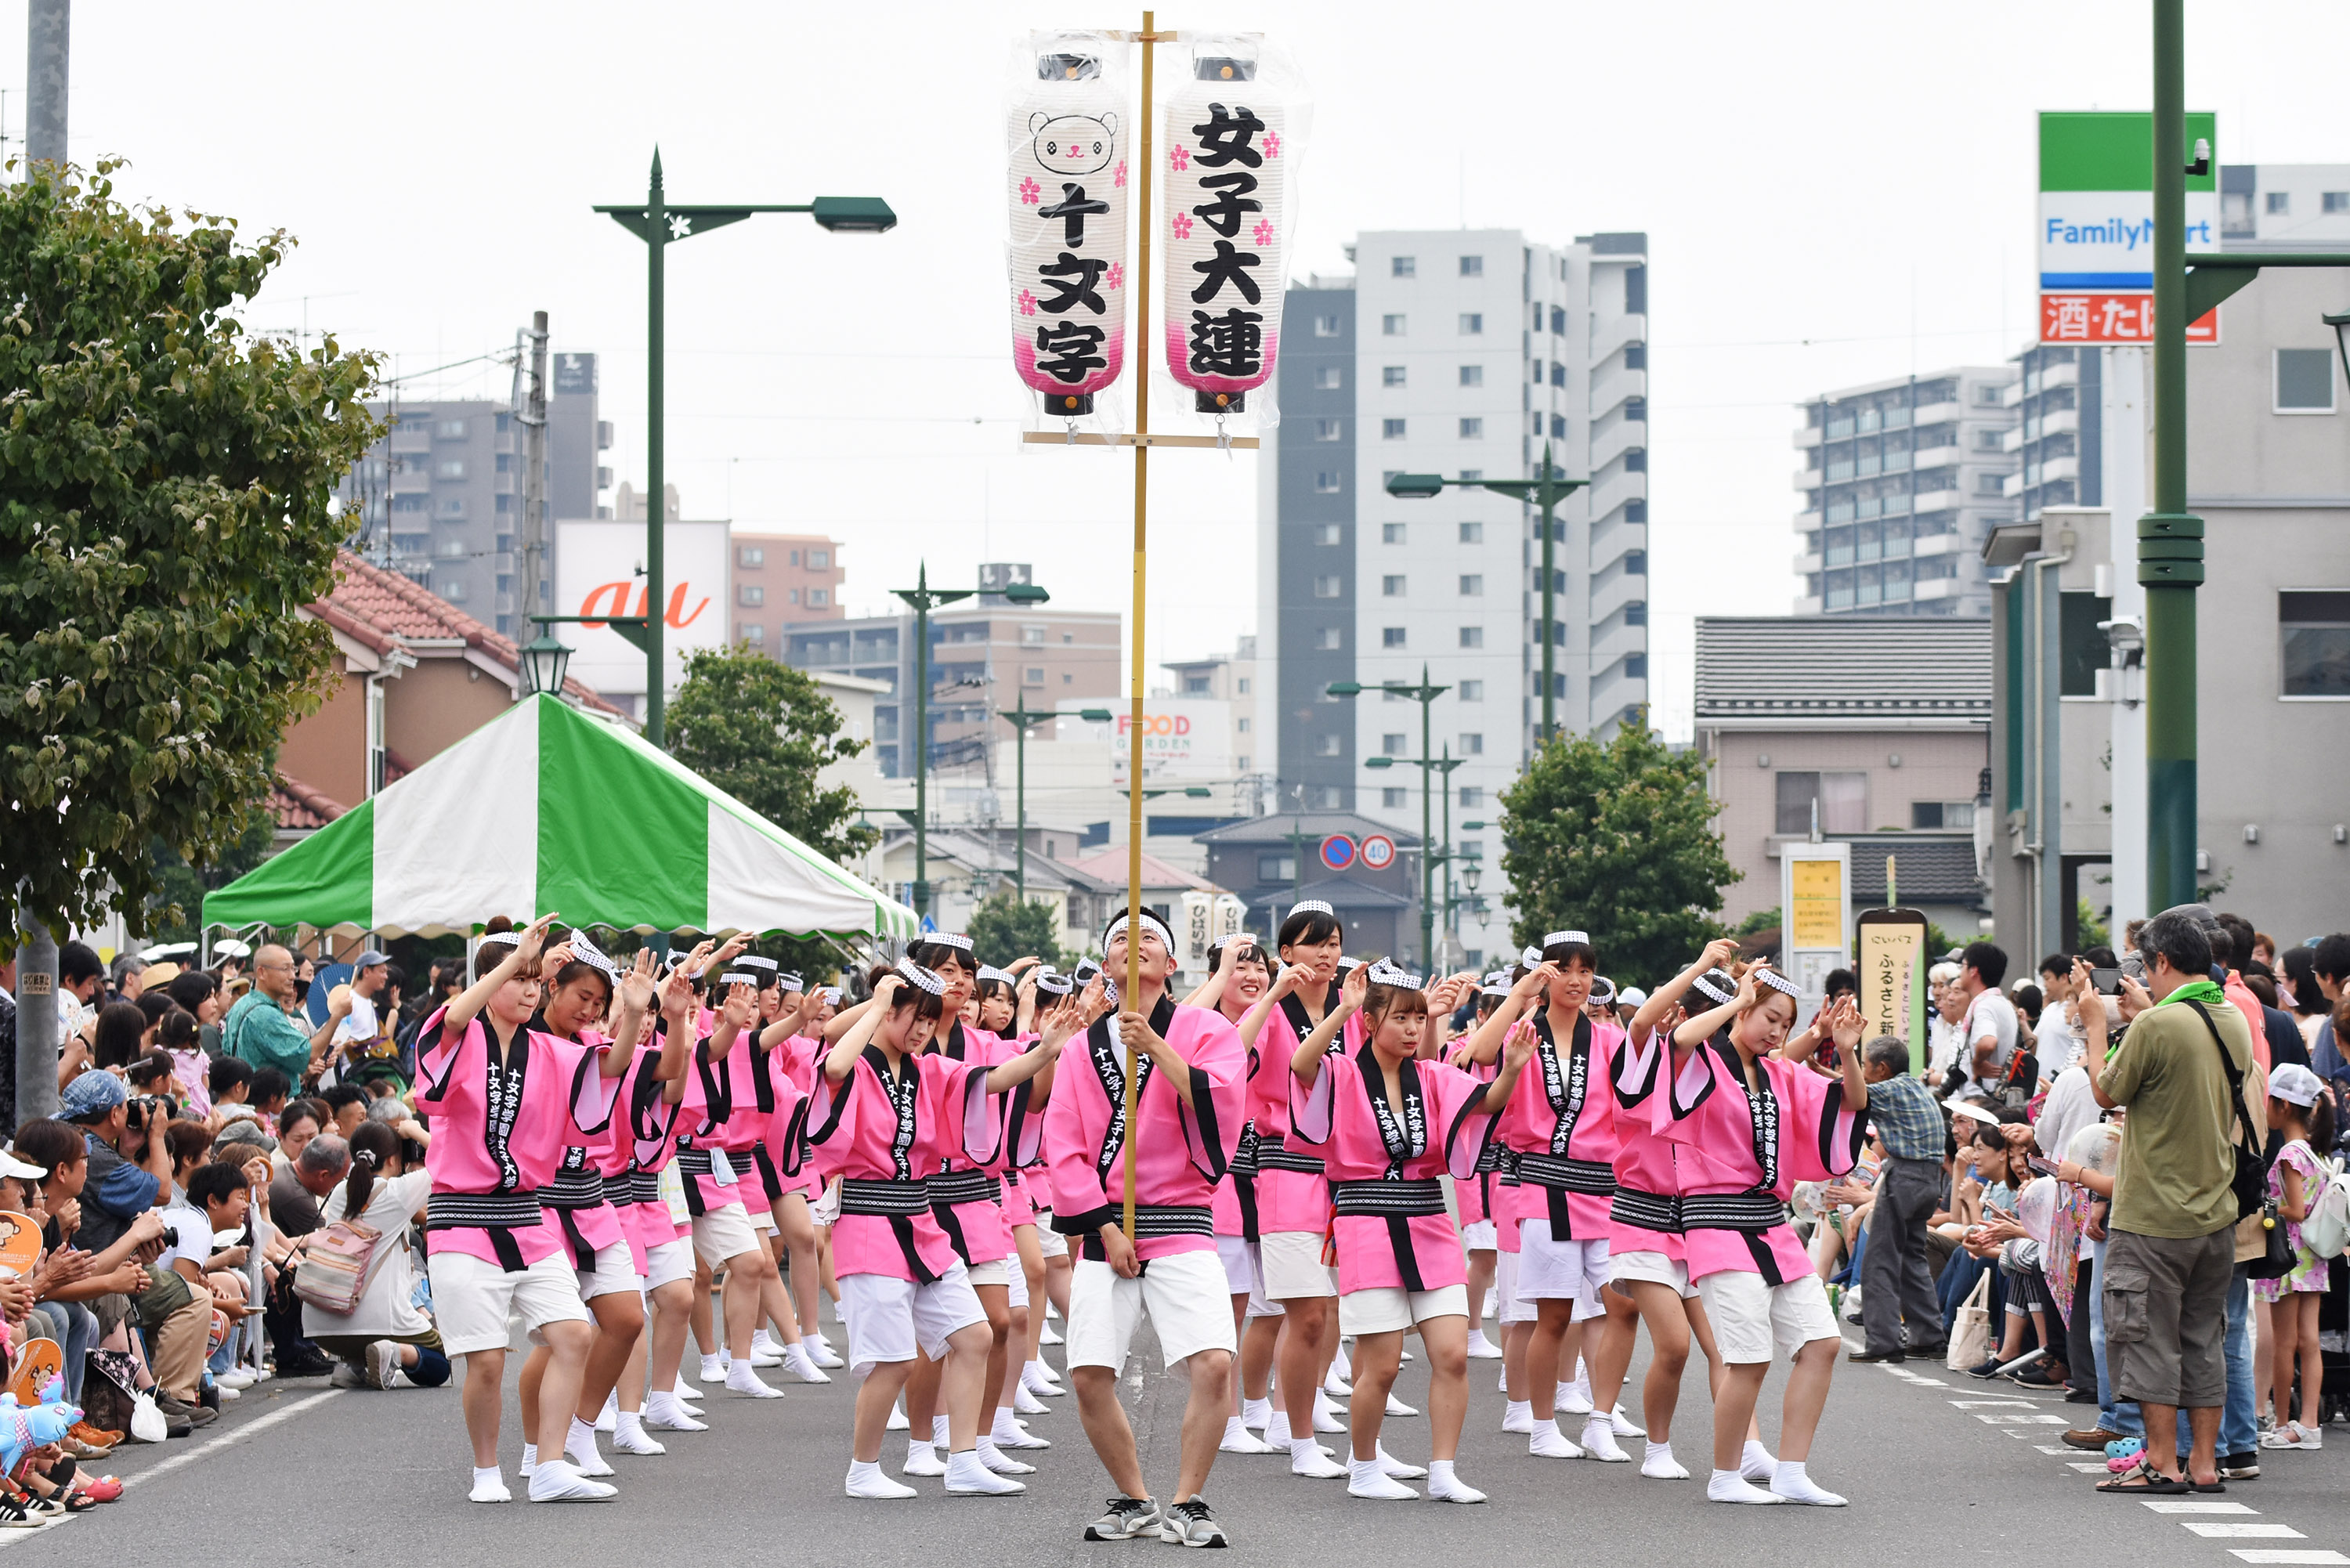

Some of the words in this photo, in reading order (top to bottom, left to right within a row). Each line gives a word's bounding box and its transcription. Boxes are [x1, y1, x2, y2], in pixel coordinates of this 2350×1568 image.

[1191, 103, 1265, 377] 女子大連
[2046, 219, 2210, 250] Familyrt
[1038, 183, 1110, 382] 十文字
[579, 581, 710, 629] au
[1116, 739, 1190, 750] GRDEN
[1118, 714, 1191, 735] FOOD
[1368, 844, 1386, 859] 40
[1225, 907, 1237, 937] ひば
[1879, 953, 1894, 1035] ふるさと新
[498, 1068, 522, 1189] 十文字学園女子大学
[894, 1079, 915, 1181] 十文字学園女子大
[1405, 1094, 1426, 1158] 十文字学園
[1553, 1054, 1586, 1154] 十文字学園女子大学
